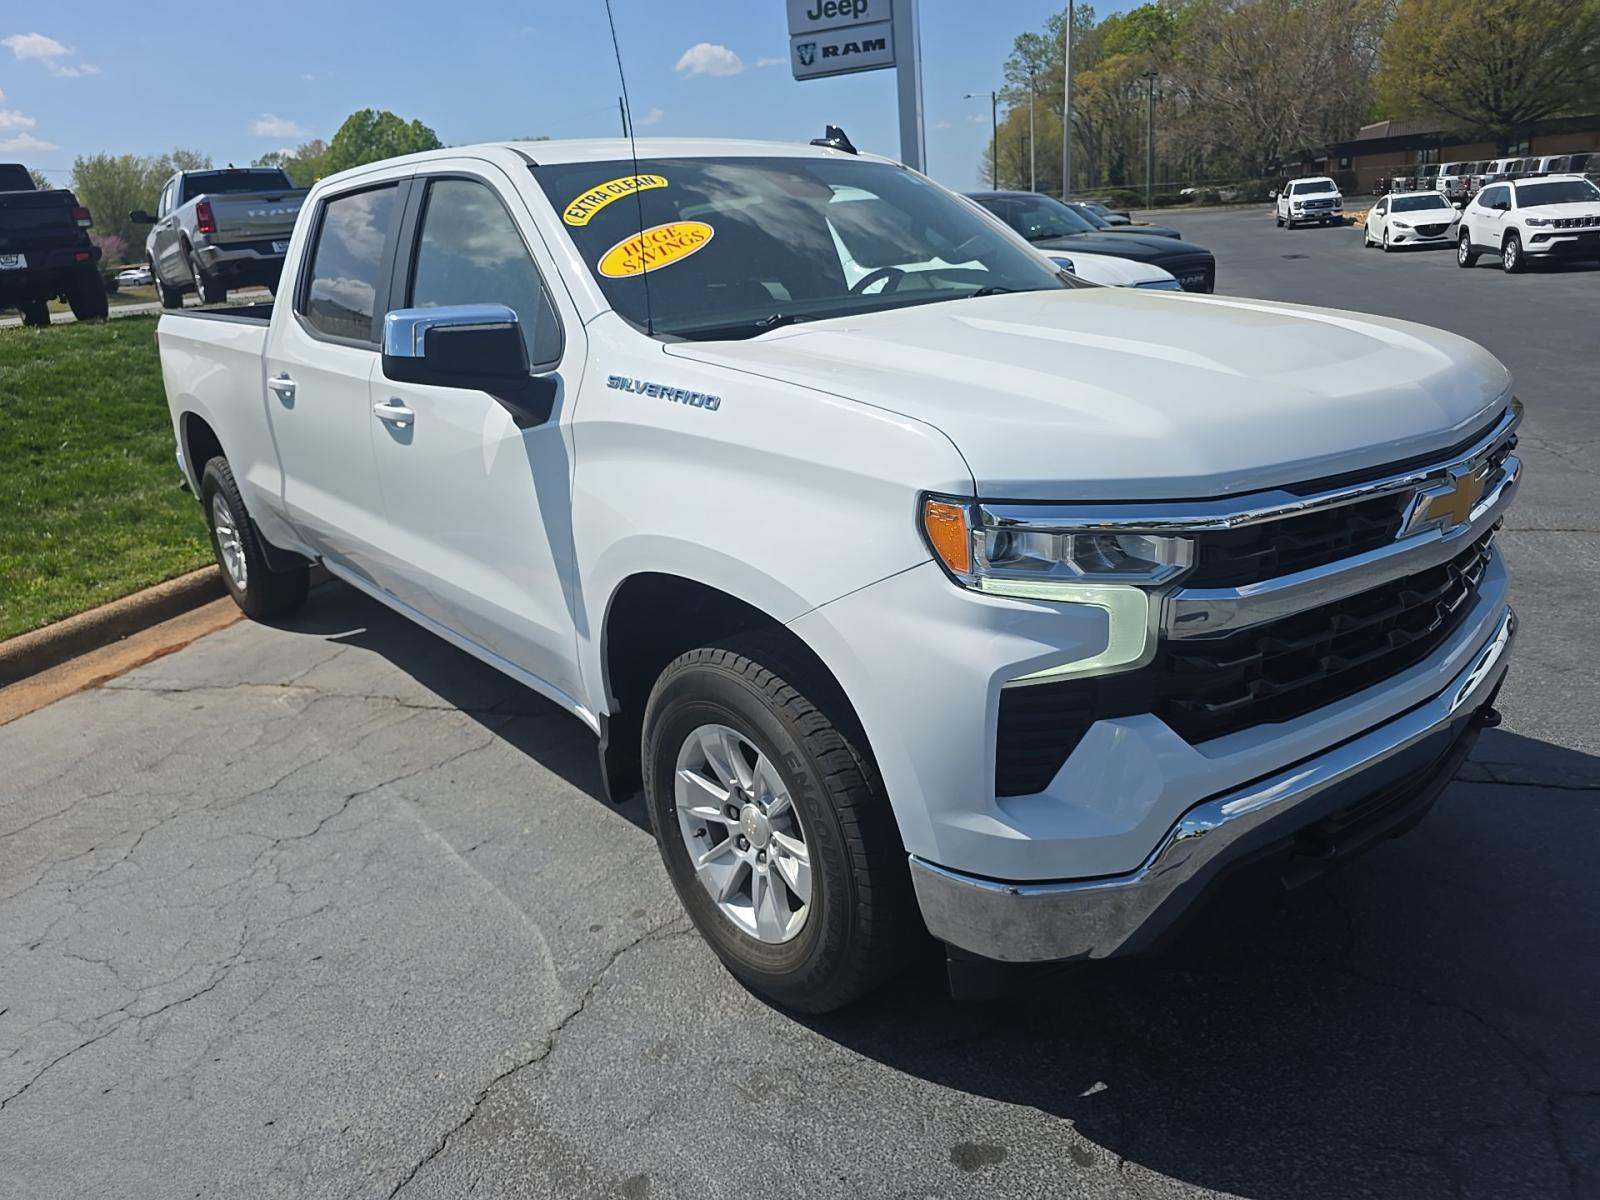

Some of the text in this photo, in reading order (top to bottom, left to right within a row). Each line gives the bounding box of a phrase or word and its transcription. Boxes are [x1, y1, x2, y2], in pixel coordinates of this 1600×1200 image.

[807, 0, 868, 20] Jeep
[822, 38, 886, 58] RAM
[567, 175, 656, 219] EXTRA CLEAN
[622, 225, 682, 257] HUGE
[622, 230, 705, 274] SAVINGS
[606, 375, 721, 411] SILVERADO
